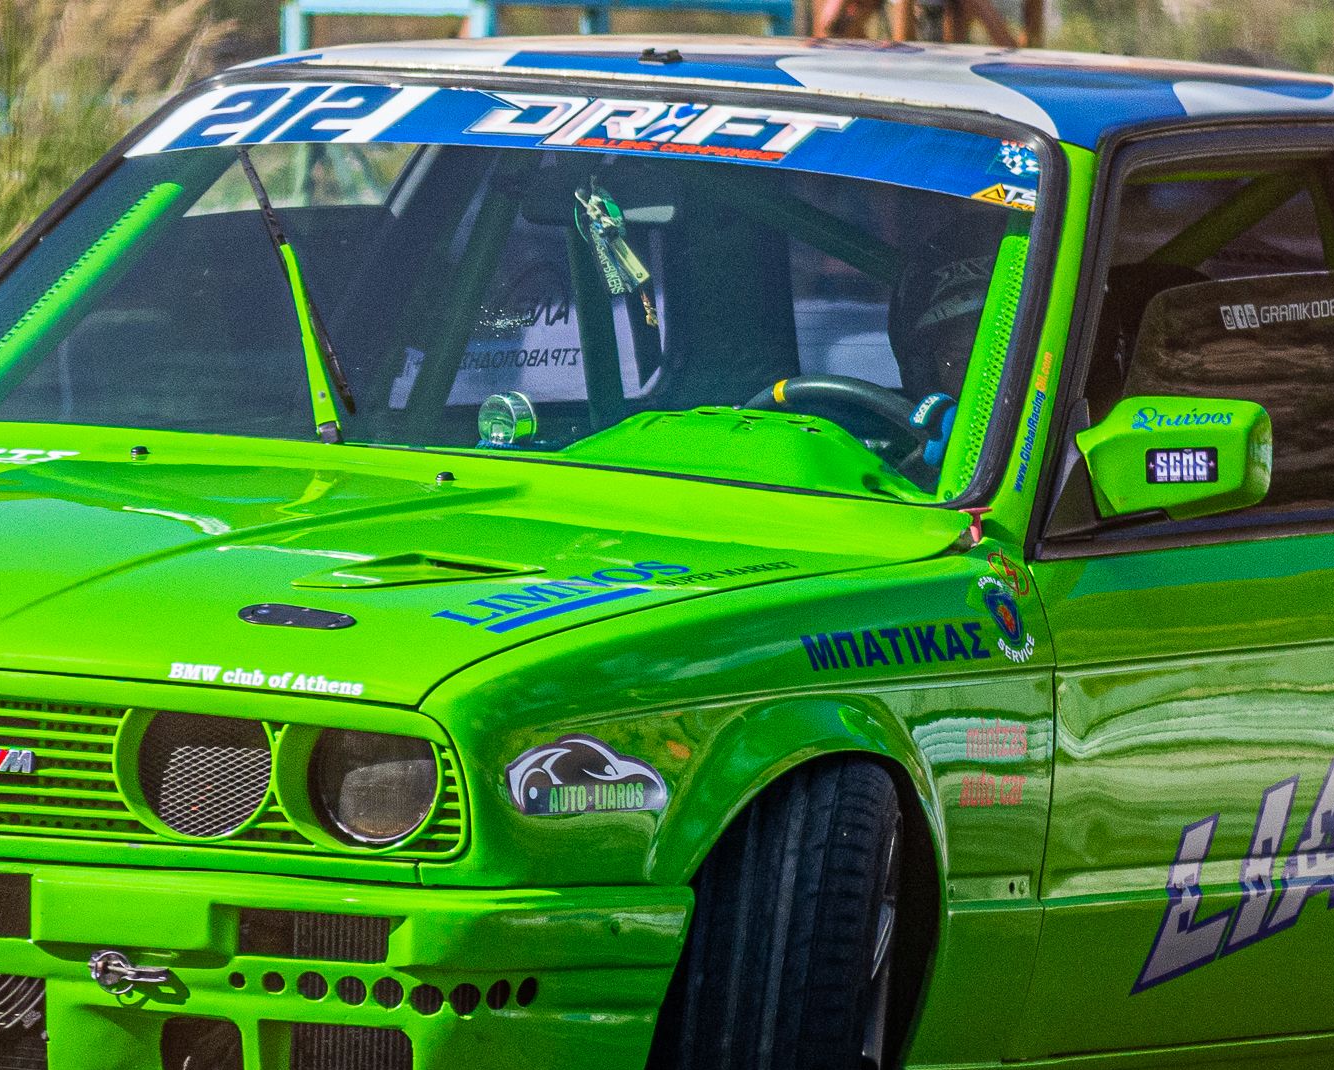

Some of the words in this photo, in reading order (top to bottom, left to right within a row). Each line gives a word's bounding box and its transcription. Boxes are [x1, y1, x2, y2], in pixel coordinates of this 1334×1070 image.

[167, 85, 404, 148] 212
[432, 561, 690, 626] LIMNOS
[800, 622, 991, 672] ΜΠΑΤΙΚΑΣ
[997, 632, 1036, 663] SERVICE
[168, 662, 222, 682] BMW
[222, 668, 265, 687] club
[268, 672, 294, 689] of
[291, 674, 364, 696] Athens
